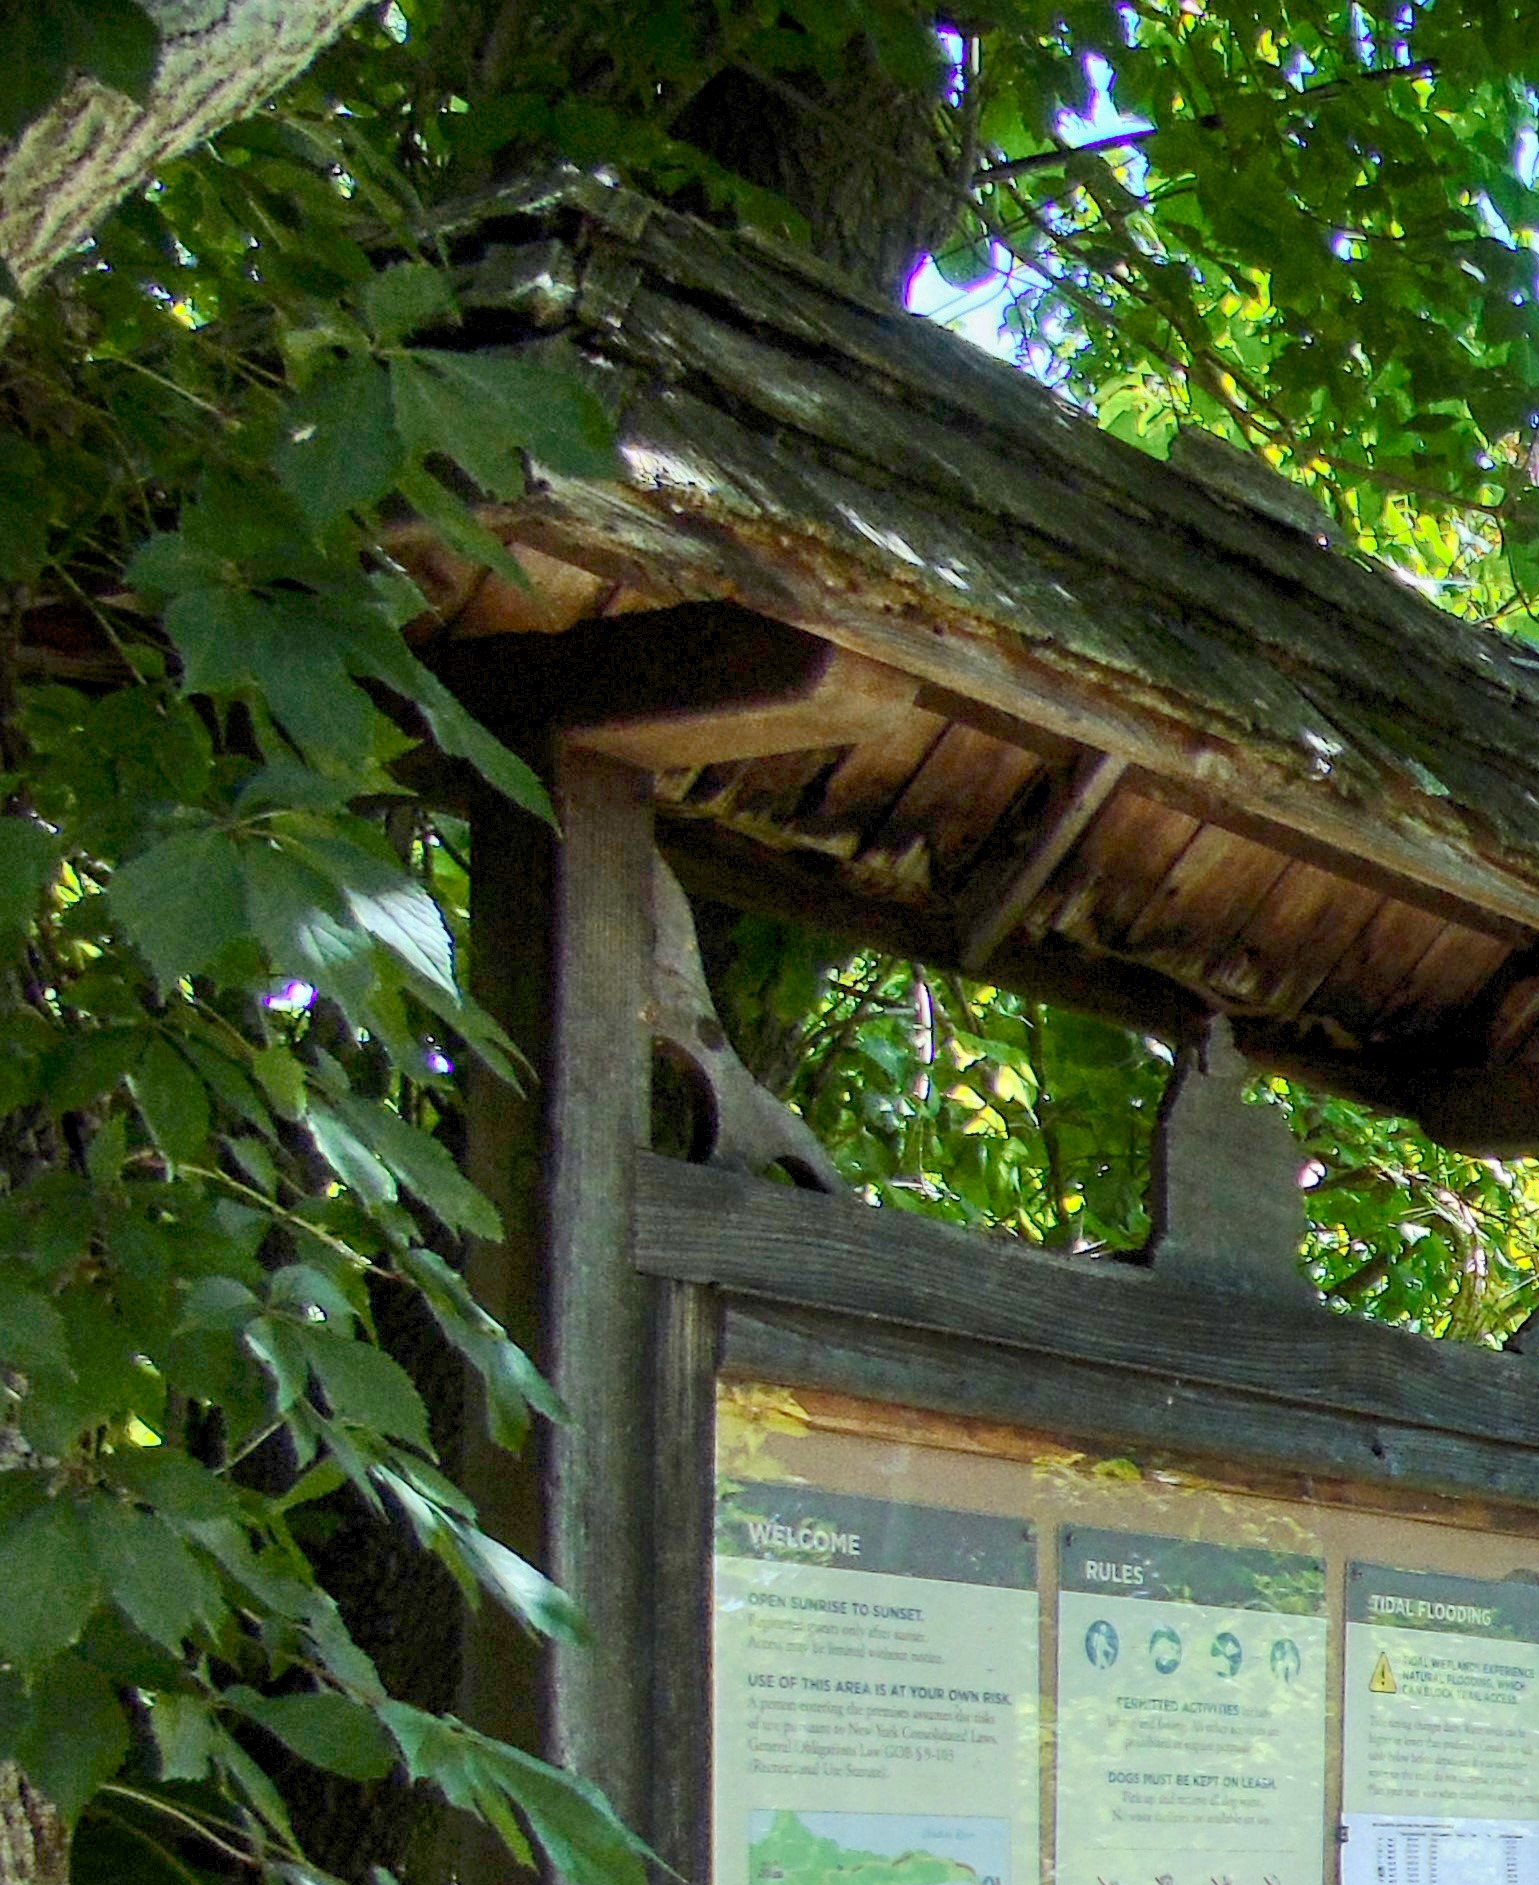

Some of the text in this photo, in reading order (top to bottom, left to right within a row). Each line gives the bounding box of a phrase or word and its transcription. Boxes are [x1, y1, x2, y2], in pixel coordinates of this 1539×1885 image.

[748, 1522, 861, 1556] WELCOME
[1085, 1560, 1144, 1584] RULES
[749, 1593, 786, 1608] OPEN
[791, 1598, 847, 1615] SUNRISE
[852, 1603, 868, 1616] TO
[1371, 1595, 1492, 1627] TIDAL FLOODING
[748, 1675, 774, 1688] USE
[779, 1677, 798, 1688] OF
[801, 1678, 831, 1691] THIS
[835, 1681, 871, 1694] AREA
[875, 1683, 886, 1695] IS
[891, 1685, 906, 1696] AT
[911, 1685, 944, 1699] YOUR
[949, 1689, 979, 1702] OWN
[1108, 1771, 1140, 1785] DOGS
[1143, 1774, 1174, 1785] MUST
[1176, 1775, 1190, 1786] BE
[1193, 1775, 1220, 1787] KEPT
[1223, 1776, 1239, 1787] ON
